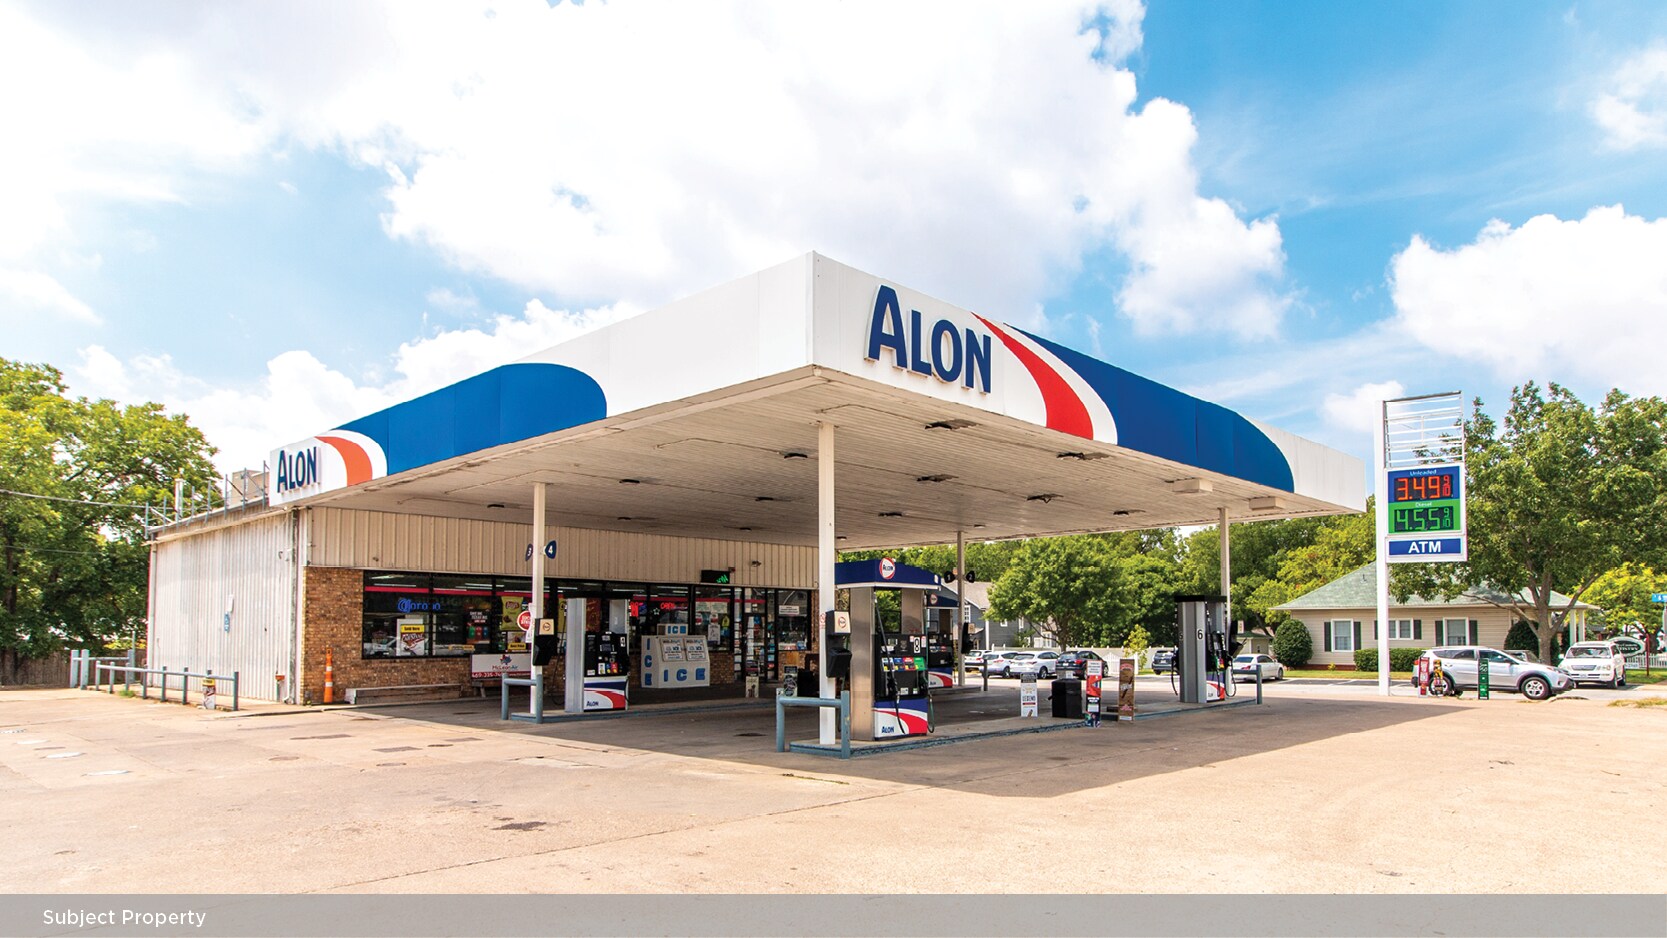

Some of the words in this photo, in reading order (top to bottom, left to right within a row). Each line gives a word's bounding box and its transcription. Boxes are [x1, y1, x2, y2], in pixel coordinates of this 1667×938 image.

[866, 284, 992, 394] ALON
[277, 446, 317, 493] ALON
[1409, 469, 1437, 477] Unleaded
[1397, 475, 1440, 500] 3.49
[1396, 508, 1440, 530] 4.55
[548, 545, 554, 555] 4
[1408, 541, 1442, 554] ATM
[667, 625, 687, 634] ICE
[1197, 629, 1204, 640] 6
[914, 638, 920, 652] 8
[663, 667, 706, 682] ICE
[882, 726, 895, 734] ALON
